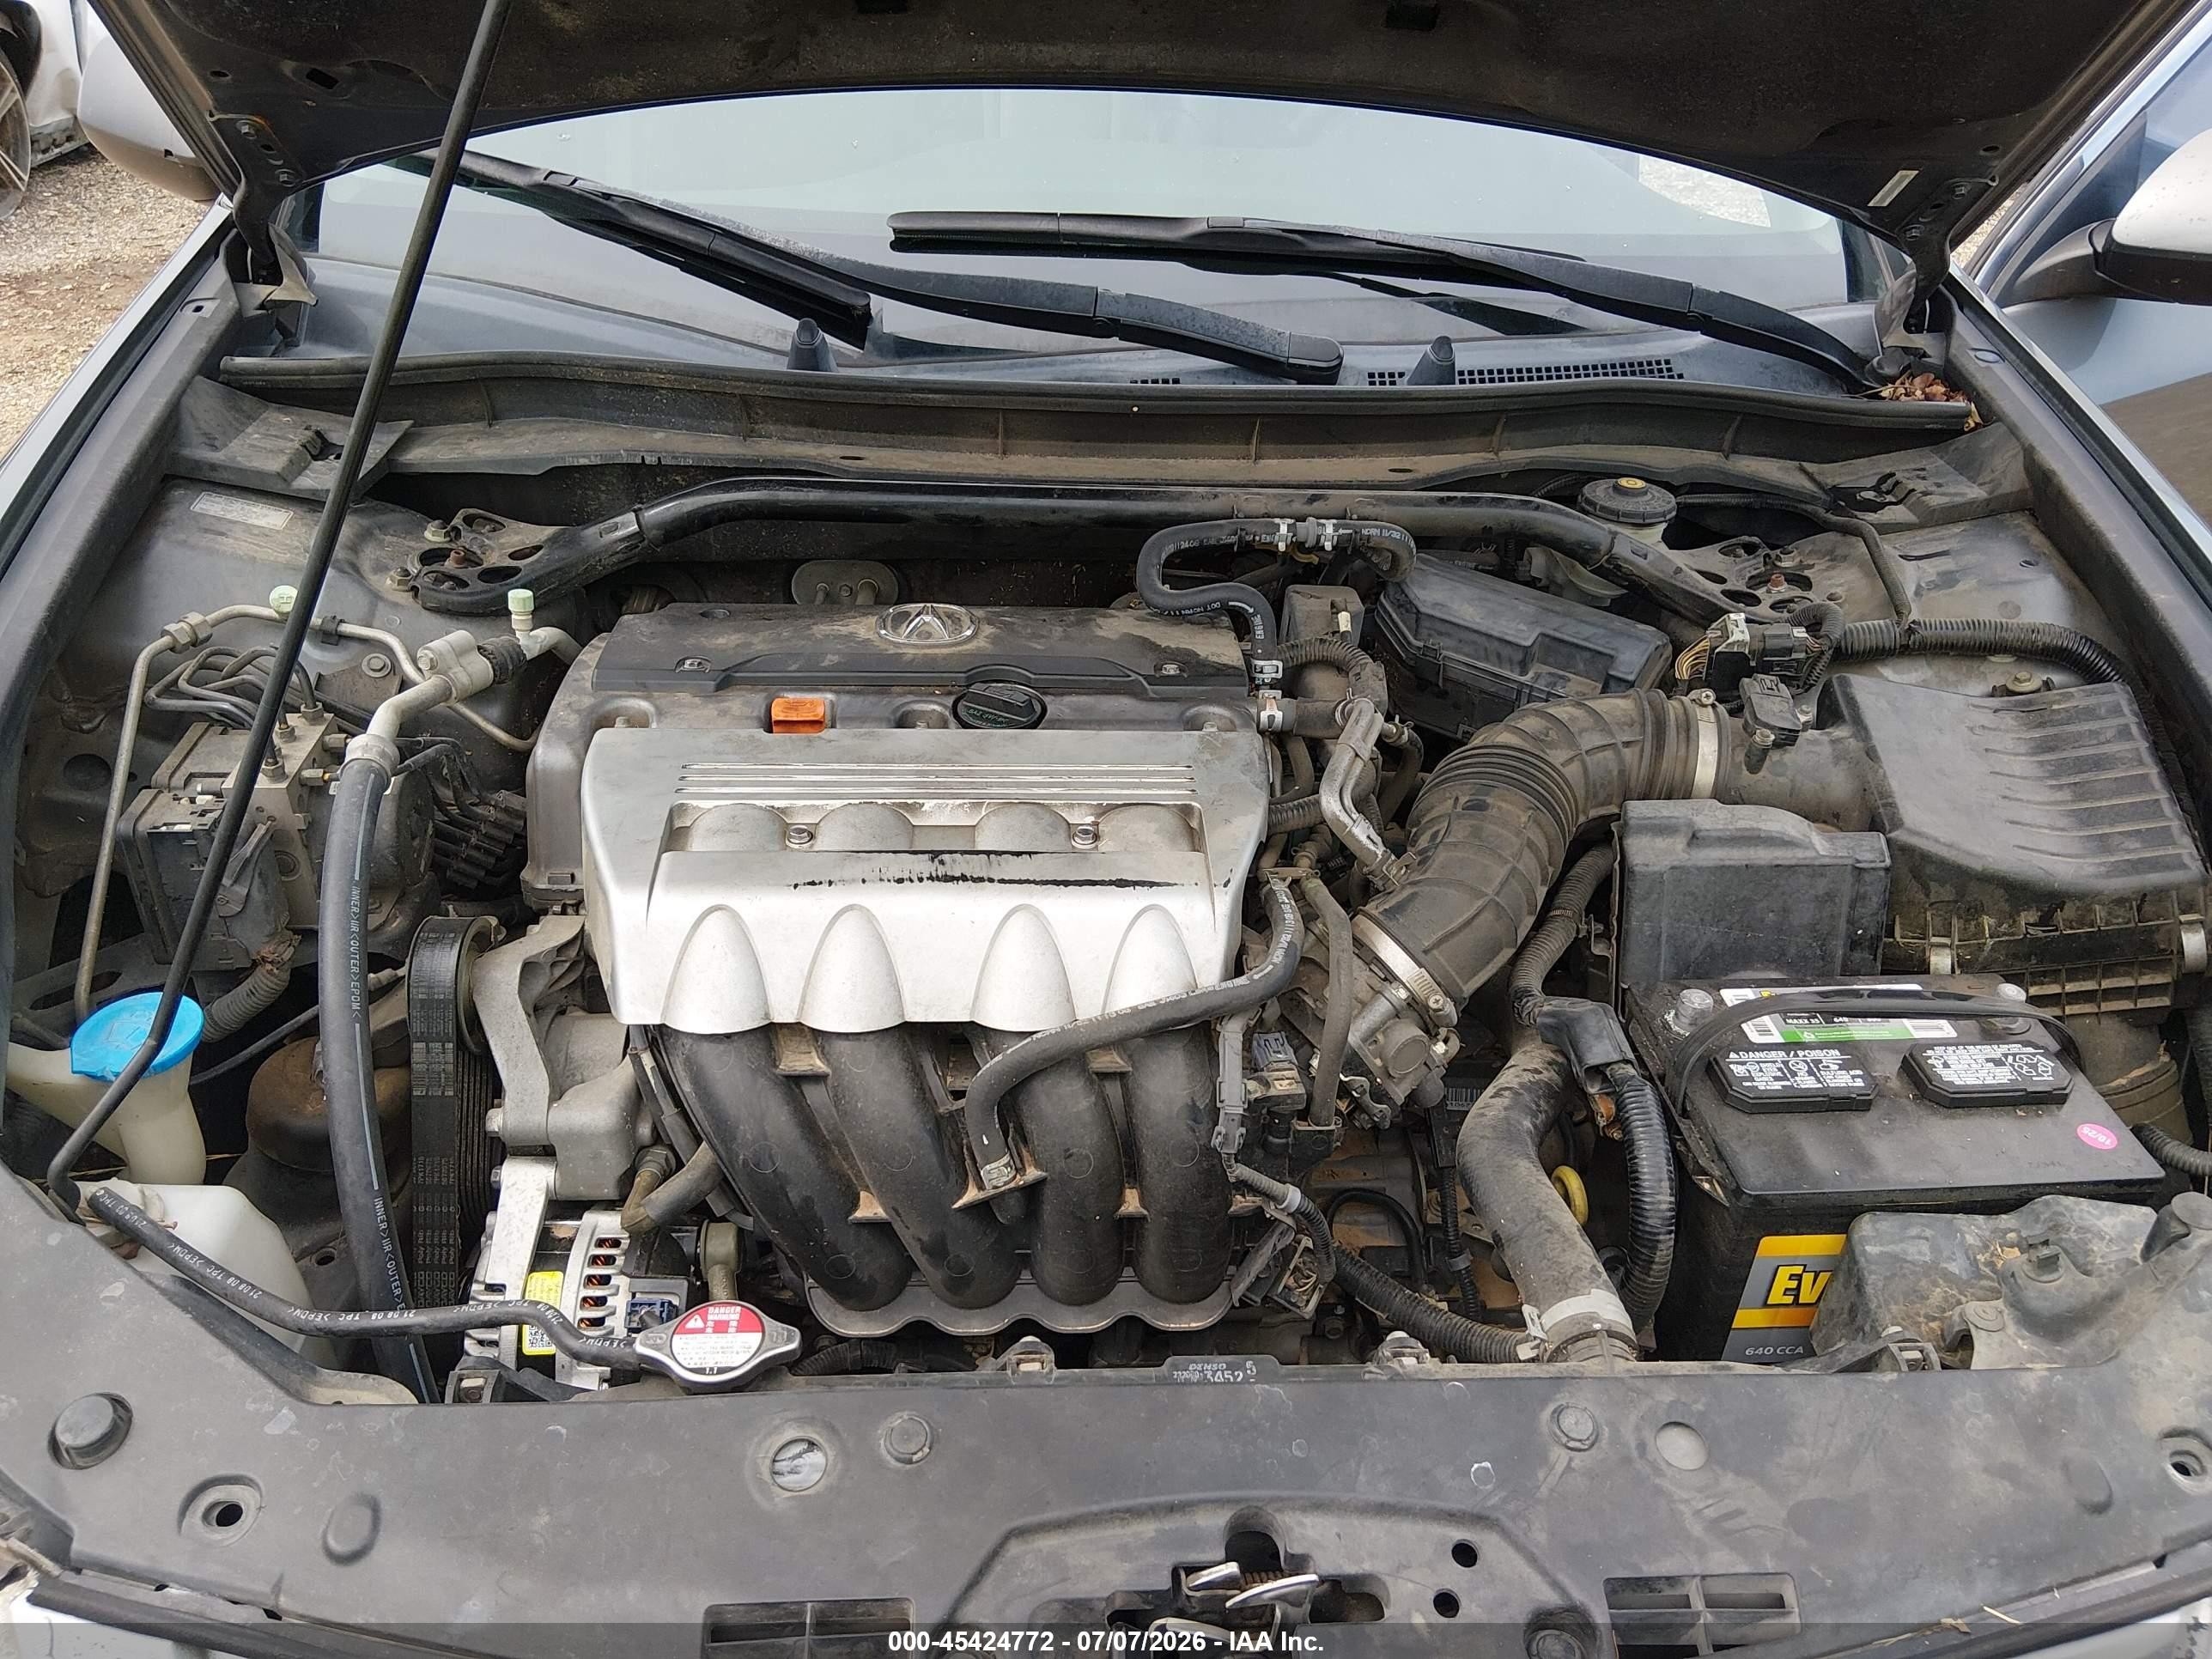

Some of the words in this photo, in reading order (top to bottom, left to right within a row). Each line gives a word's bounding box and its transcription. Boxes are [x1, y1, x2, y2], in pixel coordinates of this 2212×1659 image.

[1739, 1050, 1787, 1059] DANGER
[1796, 1048, 1841, 1058] POISON
[1765, 1263, 1834, 1306] Ev
[1745, 1347, 1774, 1356] 640
[1776, 1346, 1804, 1355] CCA
